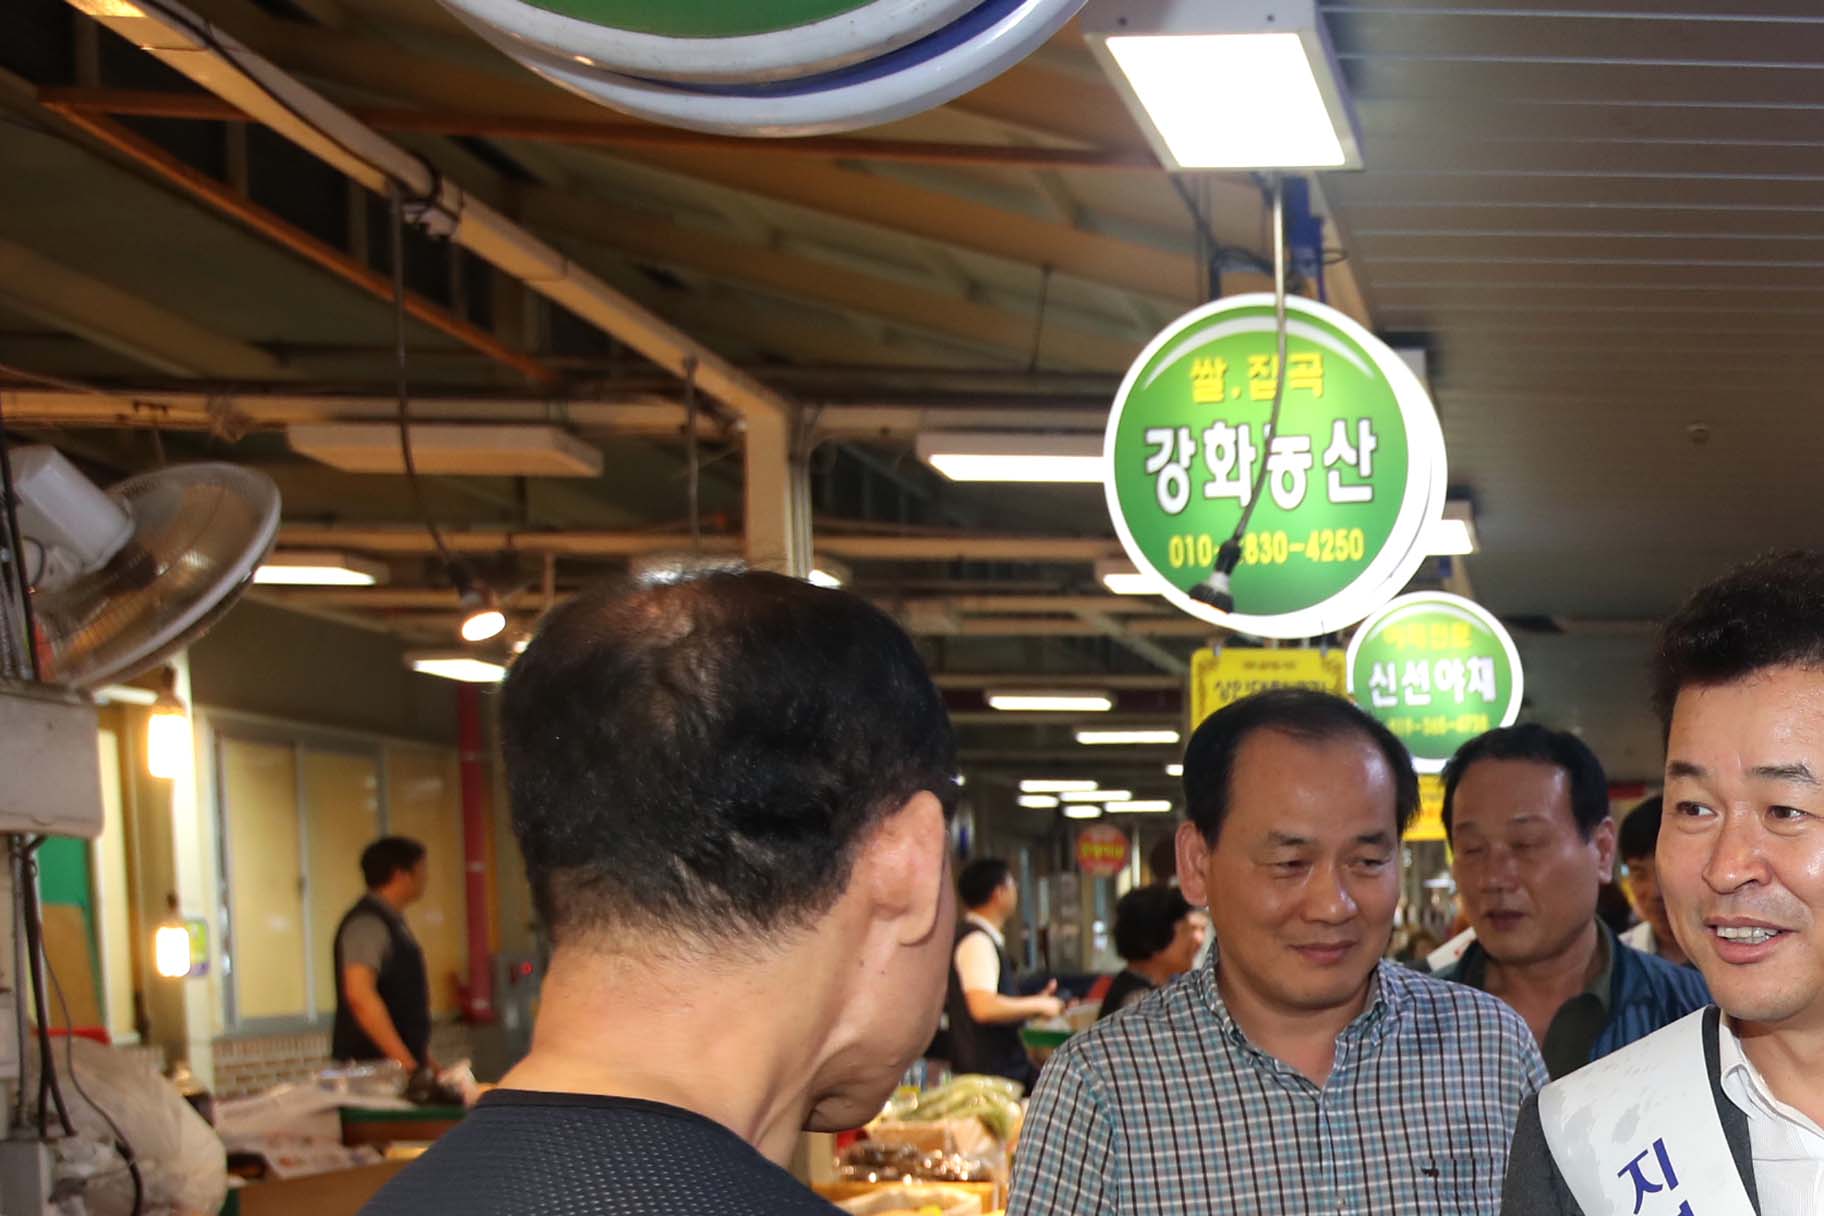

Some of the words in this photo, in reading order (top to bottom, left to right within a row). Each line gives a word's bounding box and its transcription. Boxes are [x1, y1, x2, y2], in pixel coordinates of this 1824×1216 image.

[1144, 418, 1377, 515] 강화농산
[1168, 528, 1365, 569] 010-830-4250
[1368, 655, 1498, 708] 신선야채
